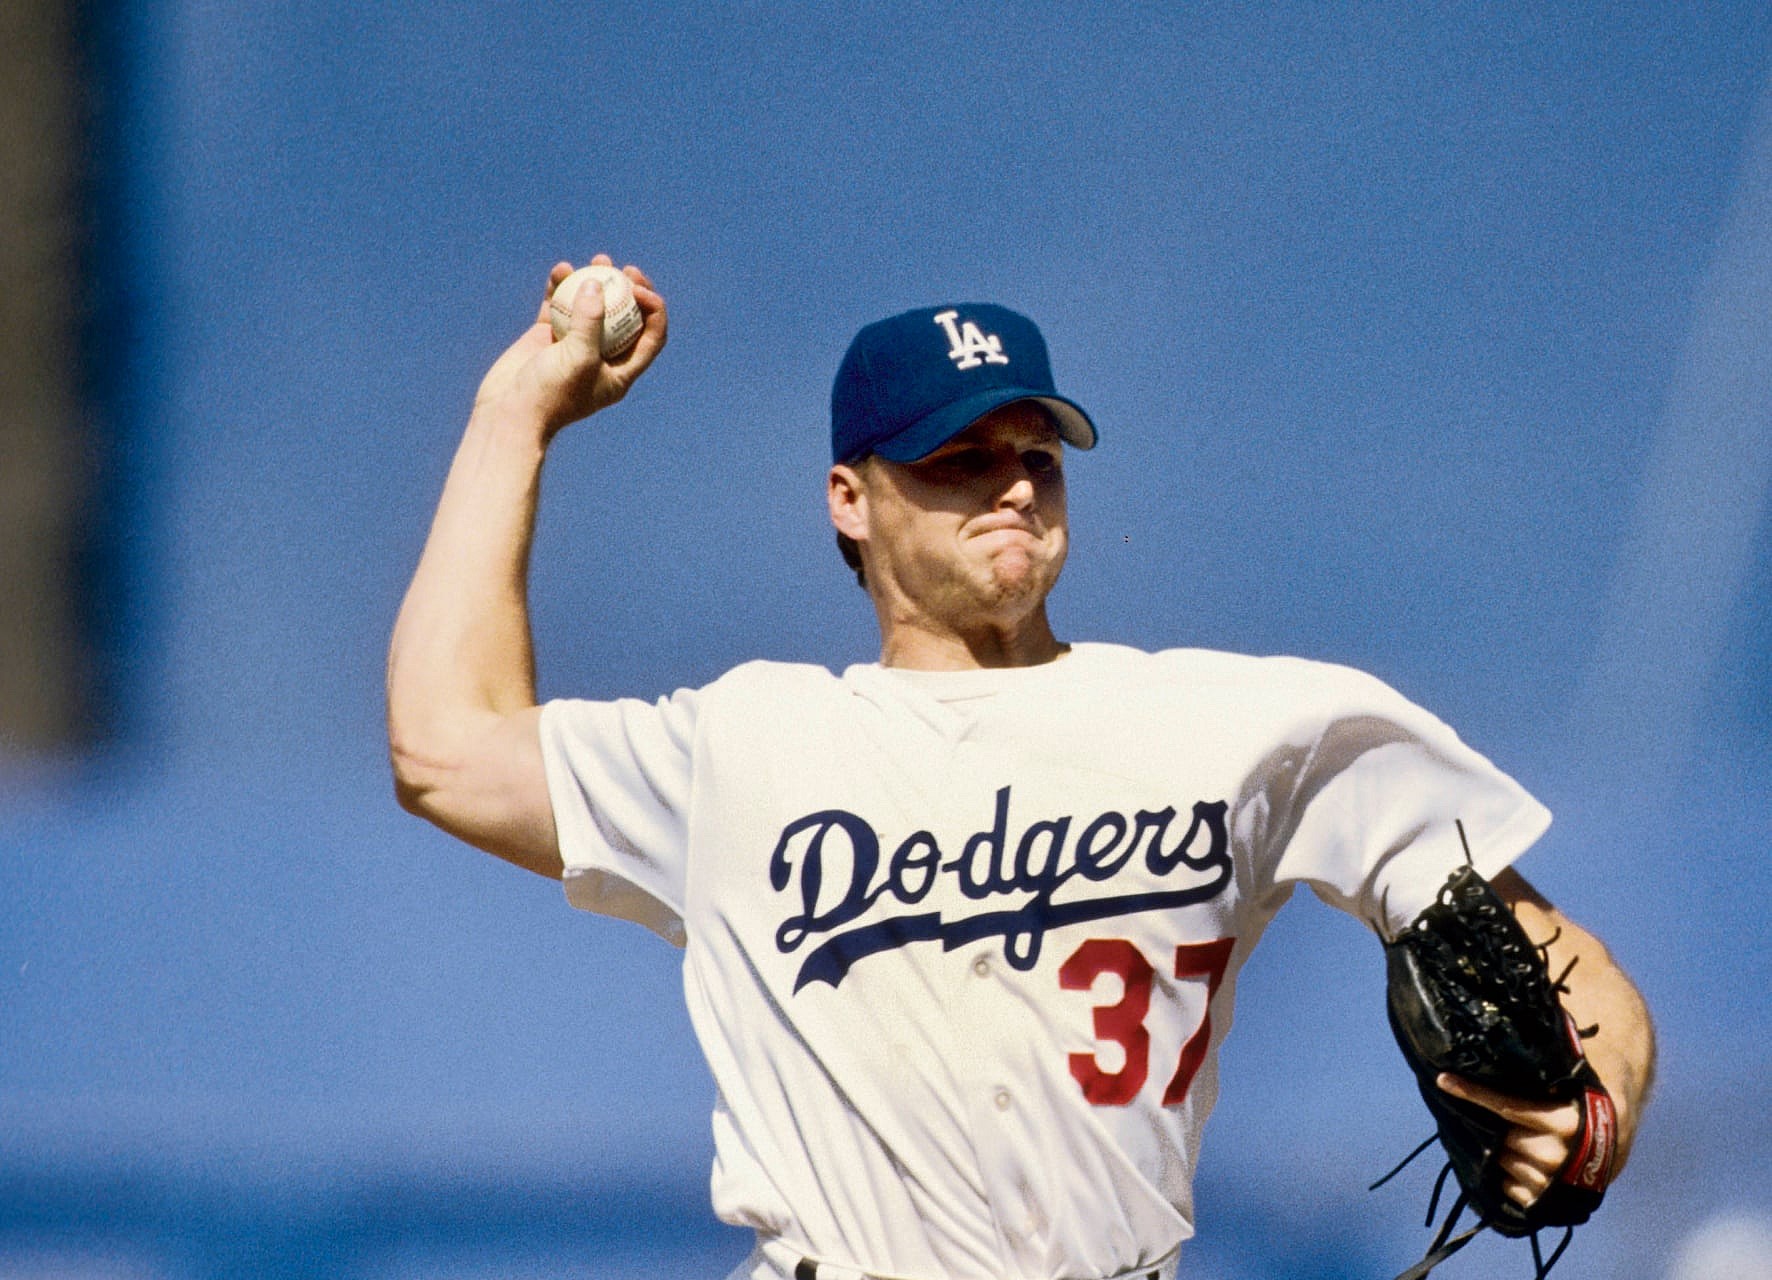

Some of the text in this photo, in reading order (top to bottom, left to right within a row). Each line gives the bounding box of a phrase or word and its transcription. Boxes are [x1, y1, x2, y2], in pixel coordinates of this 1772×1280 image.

[934, 310, 1009, 370] LA
[769, 785, 1232, 995] Dodgers
[1058, 937, 1236, 1108] 37
